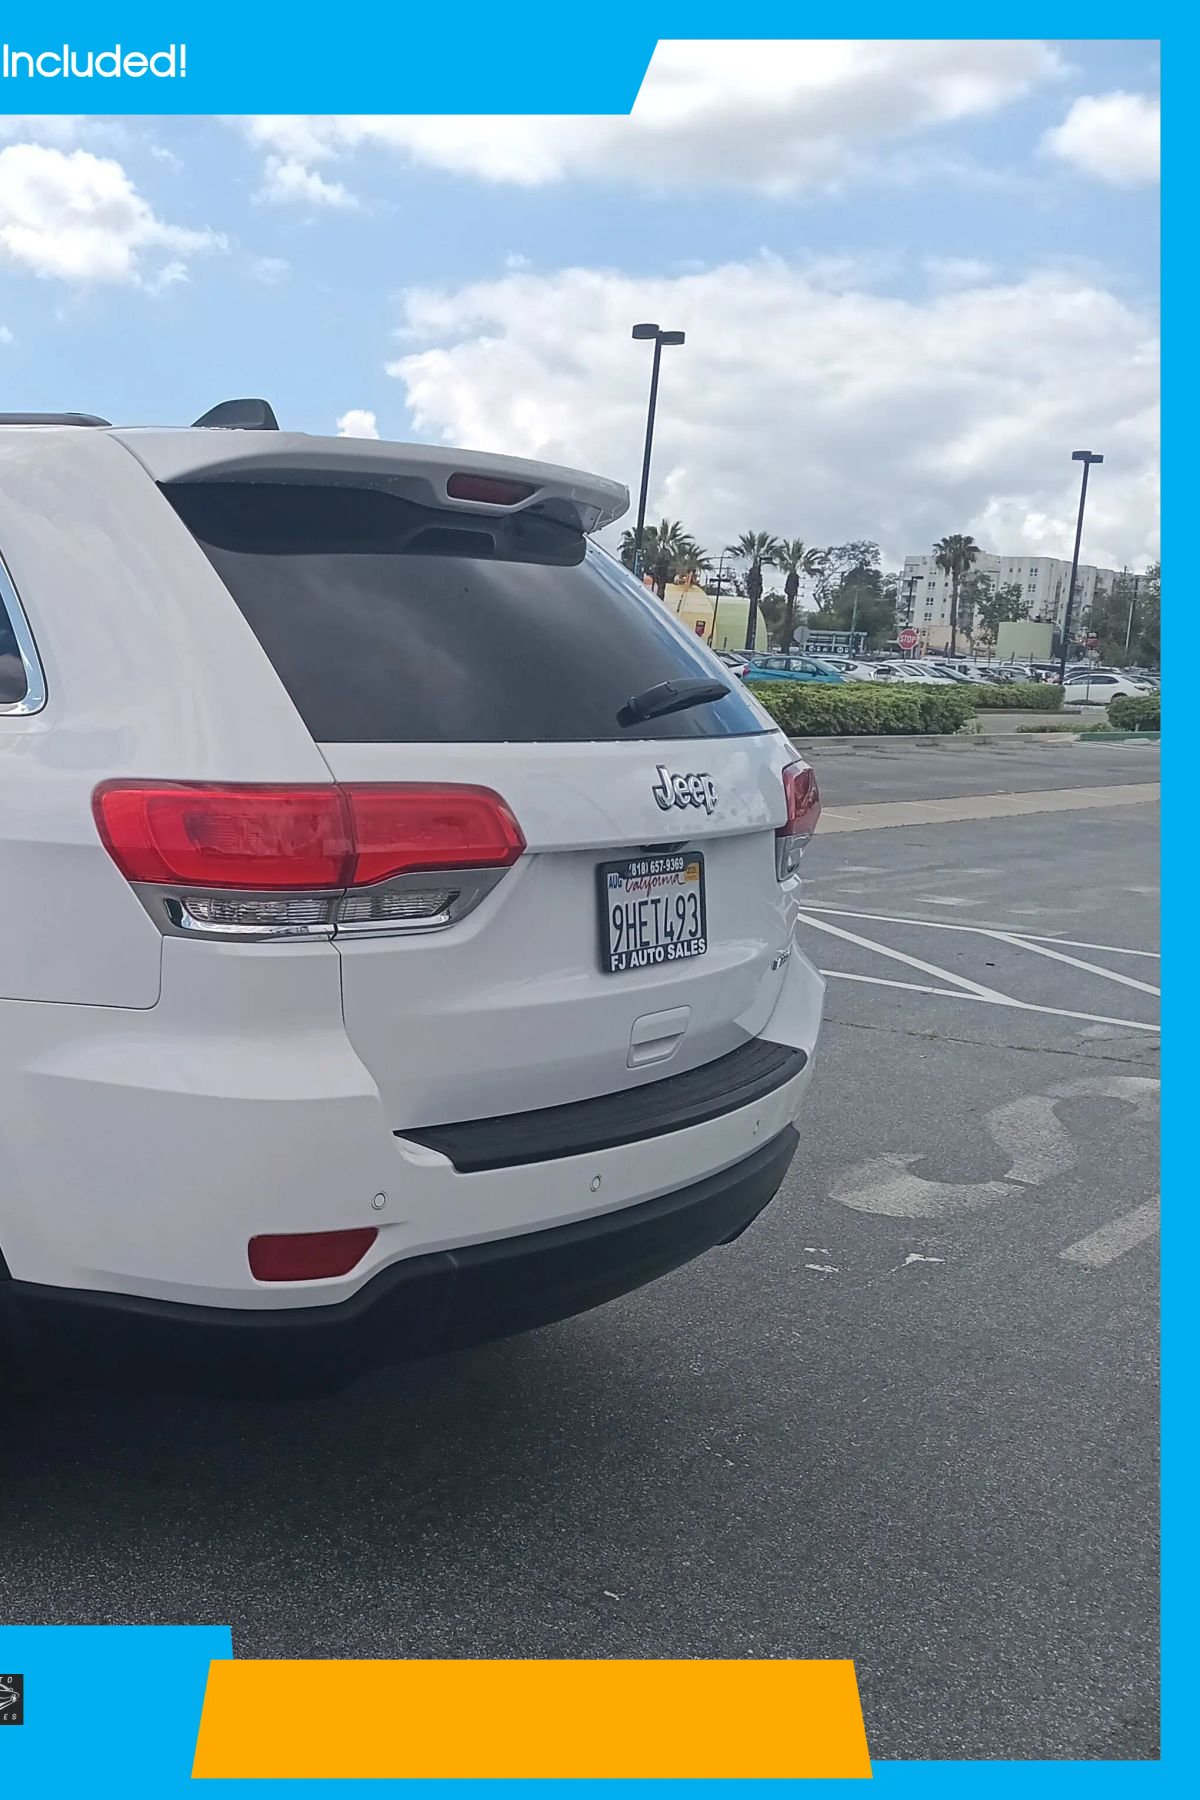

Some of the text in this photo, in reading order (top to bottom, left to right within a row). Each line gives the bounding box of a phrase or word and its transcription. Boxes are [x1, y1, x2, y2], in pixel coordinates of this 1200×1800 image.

[900, 635, 916, 643] STOP
[652, 764, 718, 815] Jeep
[629, 862, 649, 876] (818)
[650, 857, 684, 873] 657-9369
[625, 873, 685, 897] California
[612, 892, 699, 952] 9HET493
[611, 938, 706, 972] FJ AUTO SALES
